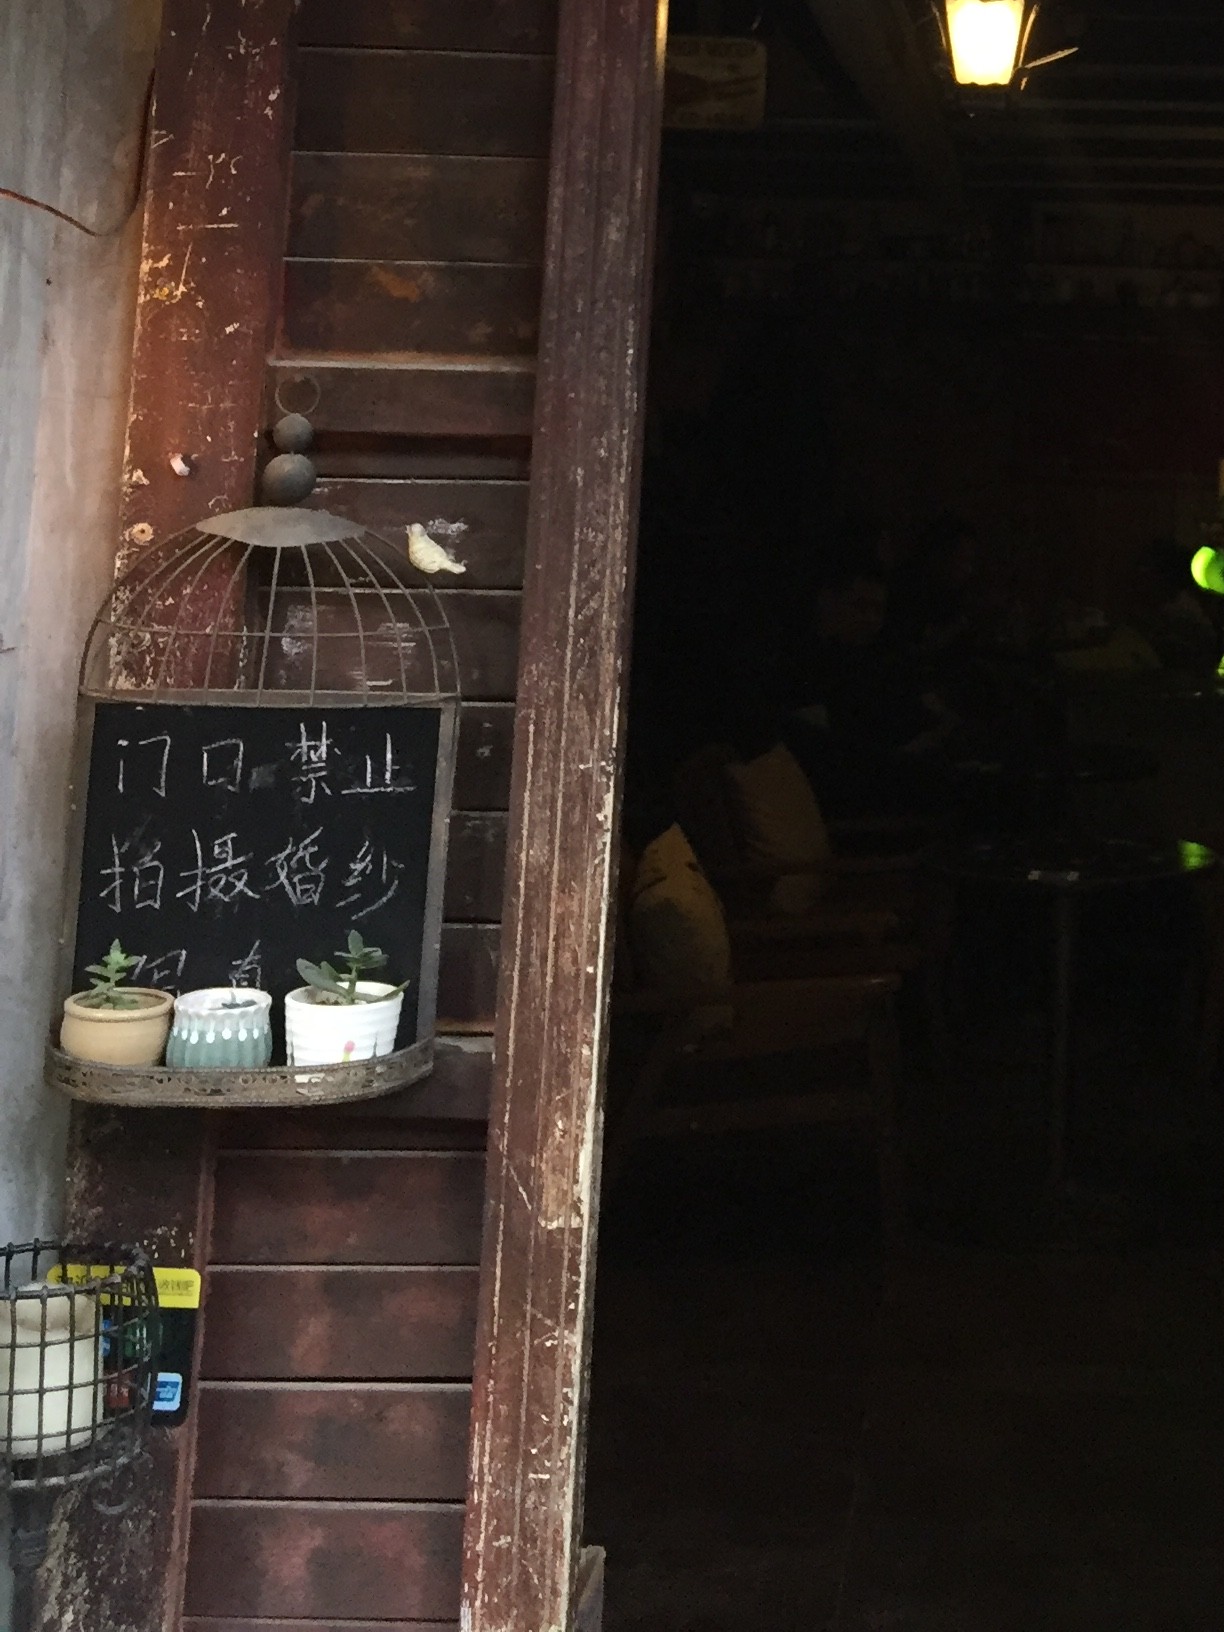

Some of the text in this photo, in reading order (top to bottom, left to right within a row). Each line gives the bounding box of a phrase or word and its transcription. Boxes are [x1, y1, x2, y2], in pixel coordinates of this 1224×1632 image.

[116, 721, 418, 804] 门口禁止
[98, 826, 406, 920] 拍摄婚纱
